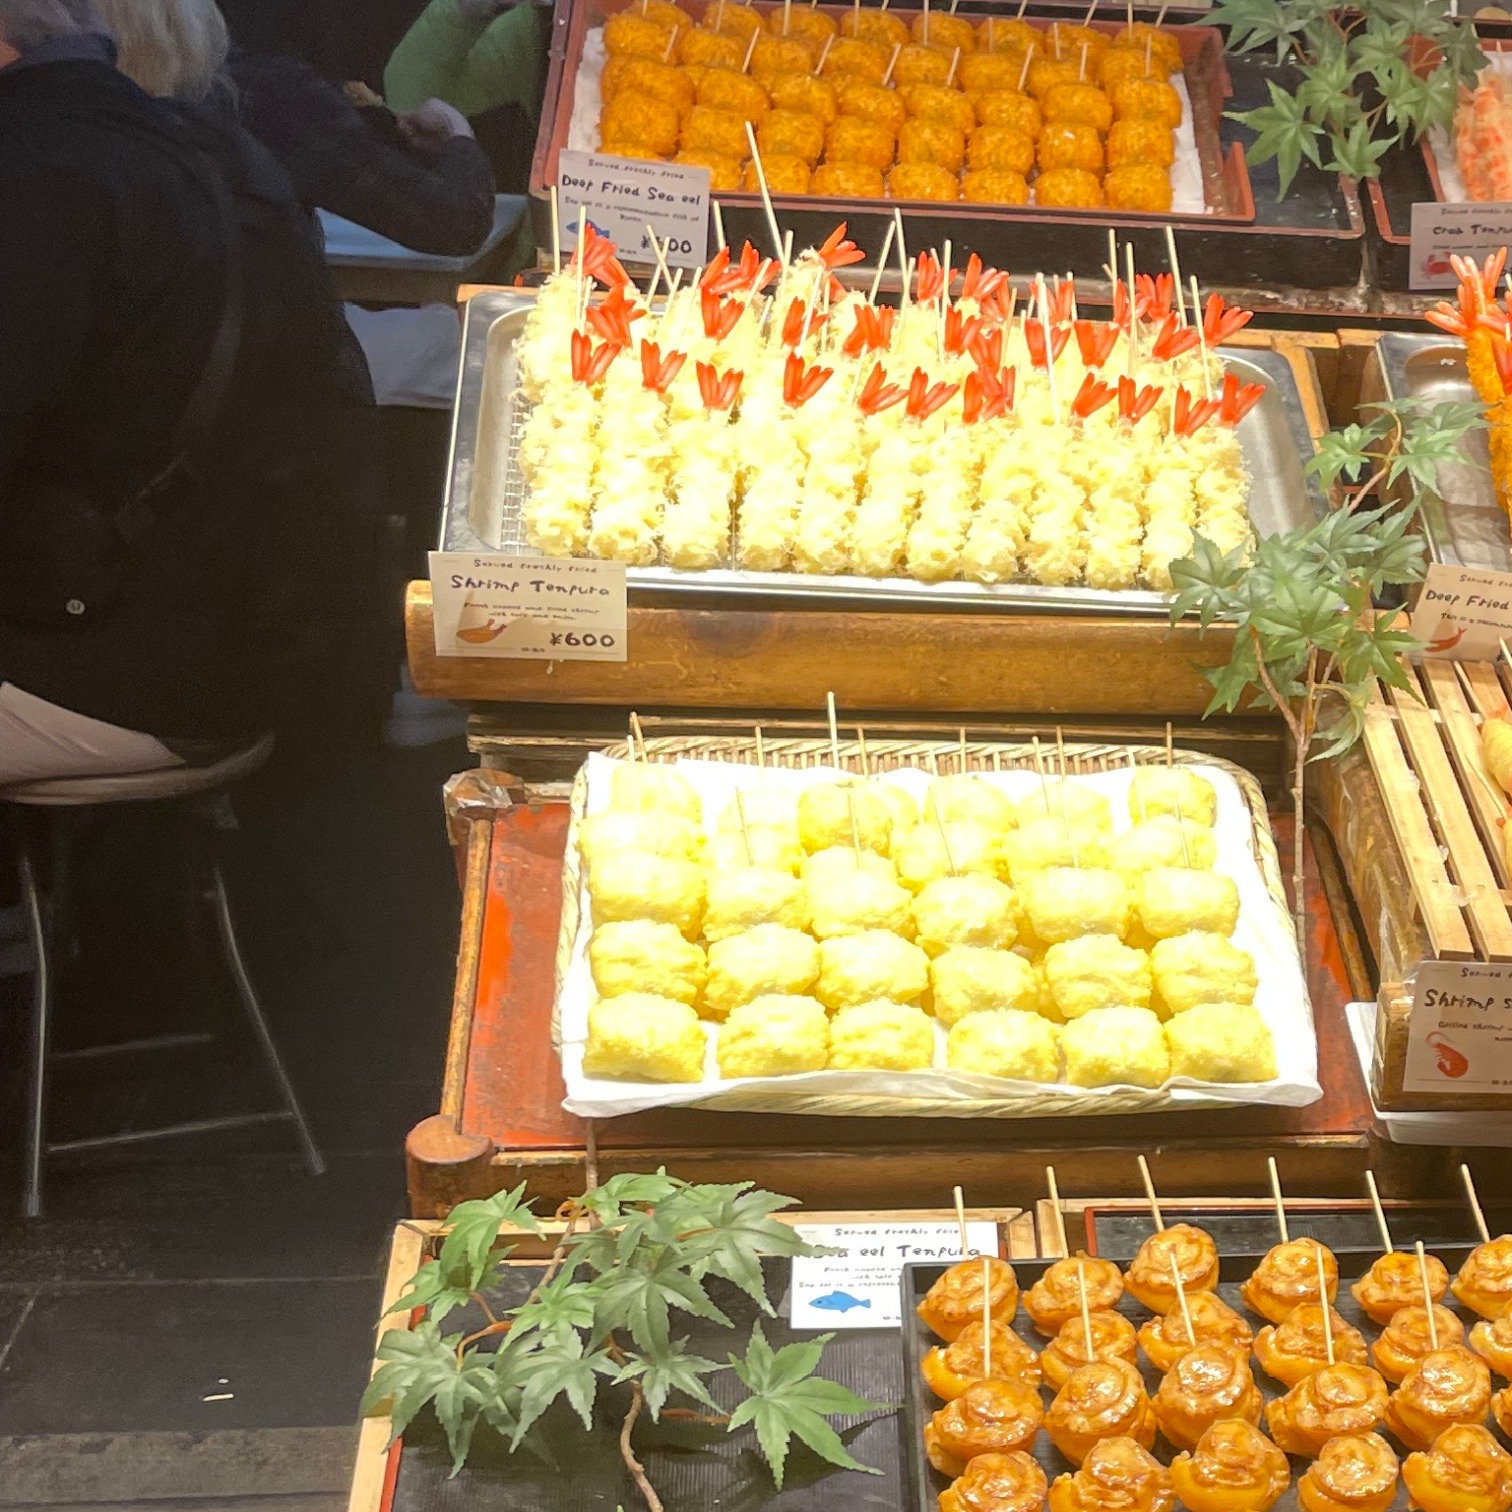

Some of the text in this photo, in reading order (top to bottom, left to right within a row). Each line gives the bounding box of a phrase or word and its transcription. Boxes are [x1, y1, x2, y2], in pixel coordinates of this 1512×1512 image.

[562, 174, 701, 206] Deep Fried Sea eel
[641, 234, 693, 254] ¥00
[451, 574, 520, 593] Shrimp
[1425, 589, 1461, 606] Deep
[1466, 595, 1509, 611] Fried
[550, 632, 615, 648] ¥600
[1424, 988, 1495, 1012] Shrimp
[859, 1245, 886, 1258] eel
